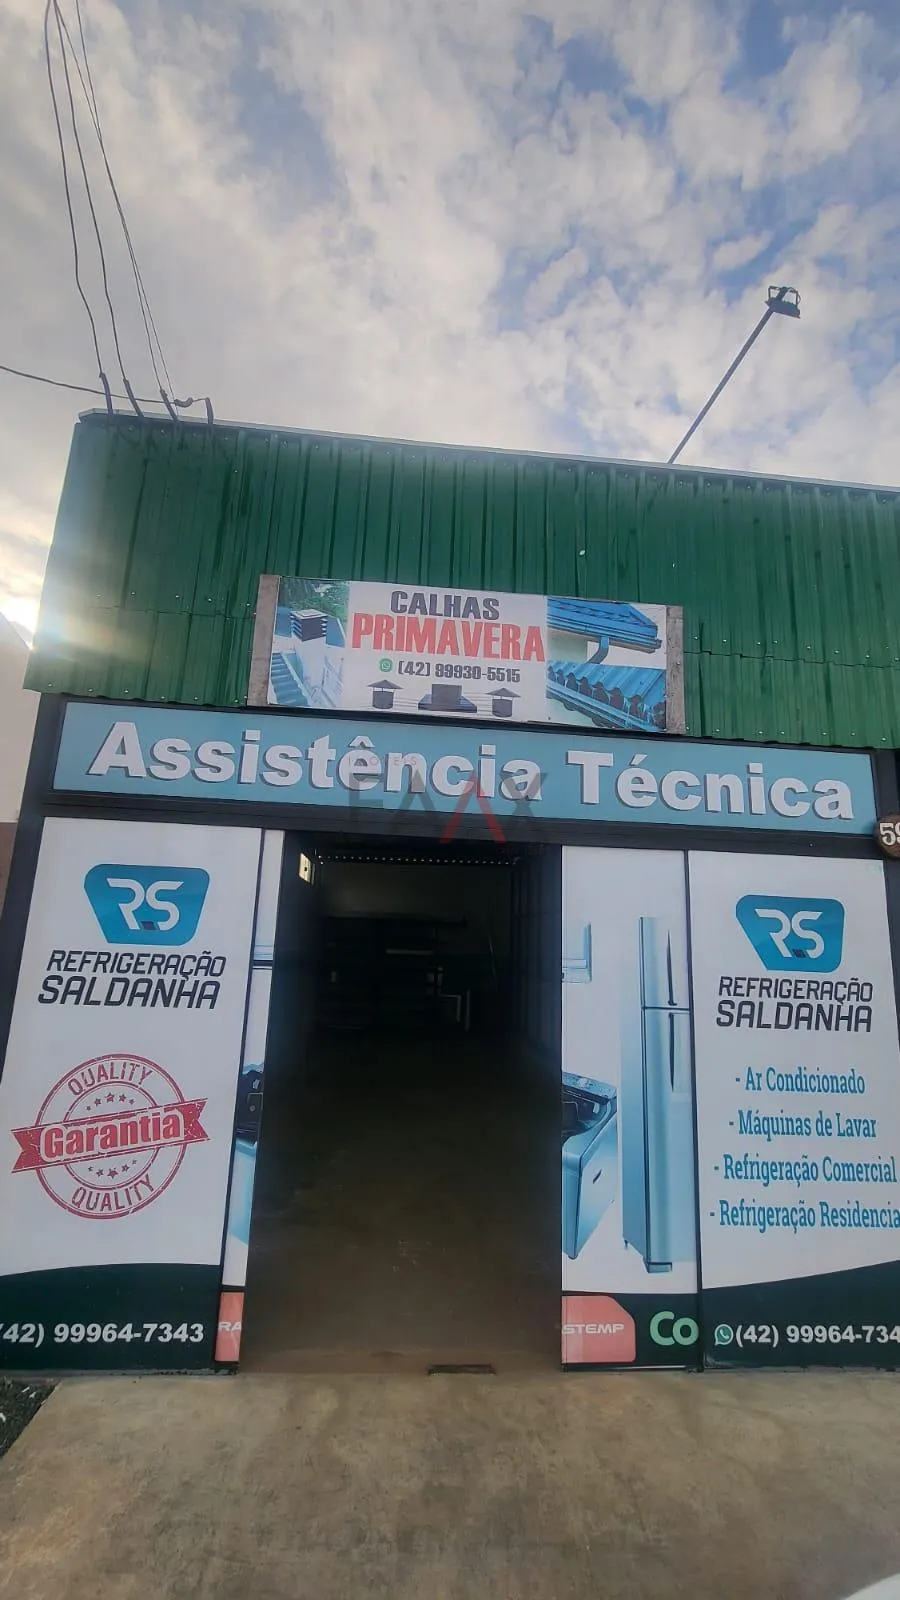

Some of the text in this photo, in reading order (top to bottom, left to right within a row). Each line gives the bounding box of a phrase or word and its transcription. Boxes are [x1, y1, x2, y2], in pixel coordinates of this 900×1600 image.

[391, 590, 500, 620] CALHAS
[352, 612, 546, 662] PRIMAVERA
[398, 660, 521, 683] (42) 99930-5515
[85, 721, 854, 821] Assistência Técnica
[106, 877, 184, 931] RS
[754, 908, 825, 959] RS
[46, 950, 227, 981] REFRIGERAÇÃO
[38, 974, 221, 1010] SALDANHA
[718, 976, 873, 1006] REFRIGERAÇÃO
[716, 999, 873, 1033] SALDANHA
[67, 1061, 153, 1096] QUALITY
[745, 1066, 762, 1091] Ar
[766, 1066, 866, 1094] Condicionado
[43, 1111, 181, 1159] Garantia
[738, 1109, 812, 1142] Máquinas
[815, 1110, 833, 1137] de
[835, 1112, 877, 1138] Lavar
[723, 1153, 819, 1188] Refrigeração
[822, 1156, 898, 1183] Comercial
[71, 1174, 156, 1212] QUALITY
[719, 1198, 816, 1234] Refrigeração
[53, 1322, 204, 1344] 99964-7343
[649, 1311, 699, 1346] Co
[735, 1324, 779, 1348] (42)
